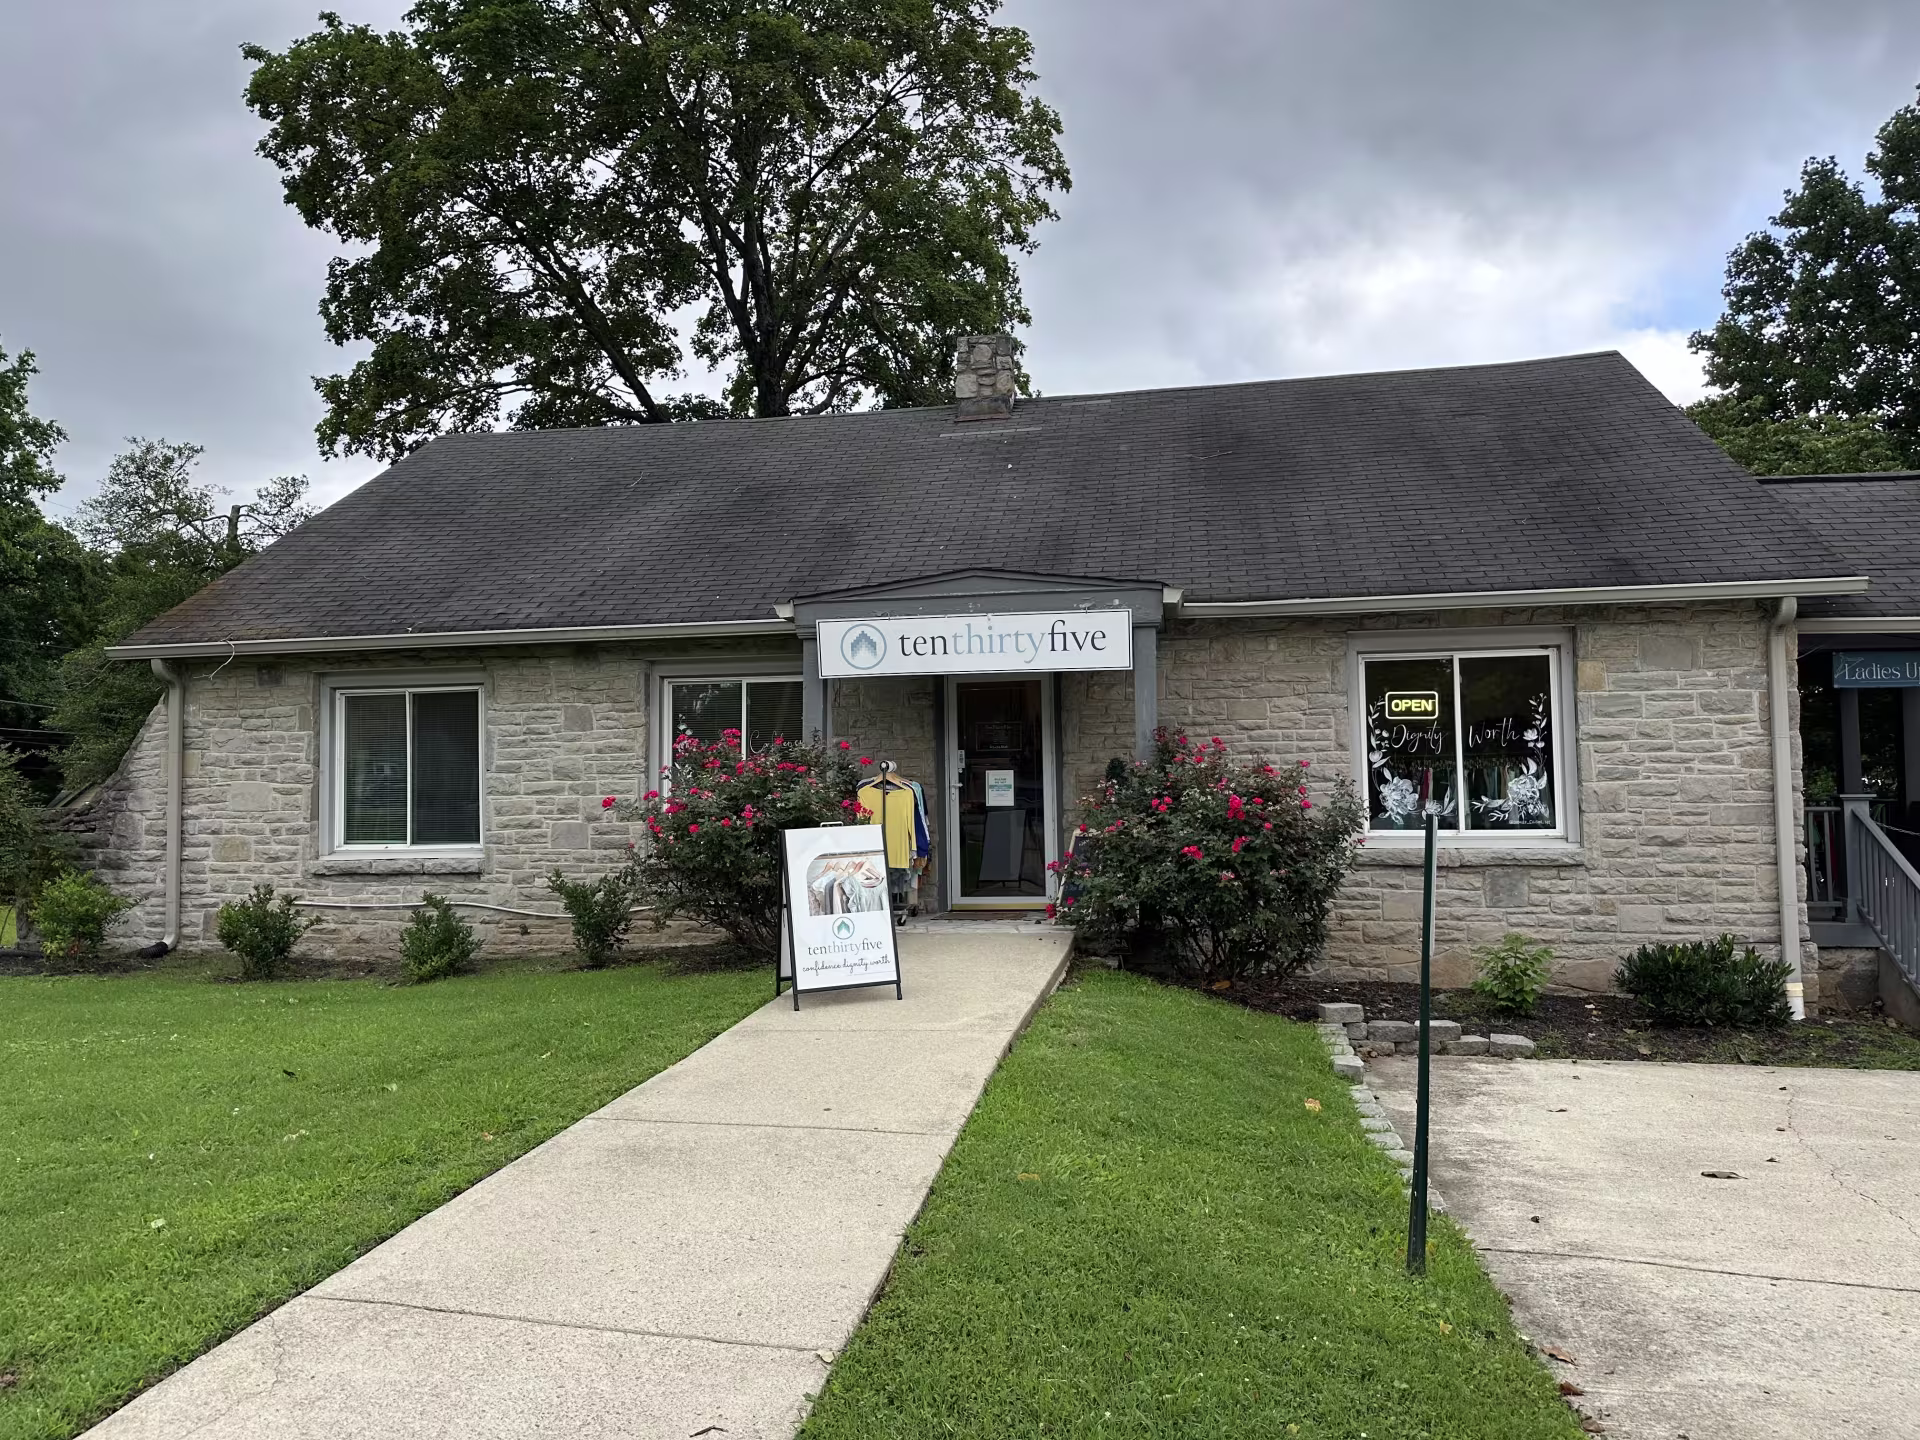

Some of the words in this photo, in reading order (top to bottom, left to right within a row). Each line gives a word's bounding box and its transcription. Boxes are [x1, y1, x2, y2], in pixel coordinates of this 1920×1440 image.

[898, 619, 1106, 664] tenthirtyfive
[1845, 663, 1901, 680] Ladies
[1906, 662, 1920, 685] U
[1391, 699, 1433, 712] OPEN
[1391, 720, 1447, 755] Dignity
[1468, 717, 1520, 749] Worth
[808, 938, 883, 956] tenthirtyfive
[802, 960, 841, 977] confidence
[842, 958, 869, 974] dignity
[869, 954, 891, 966] worth
